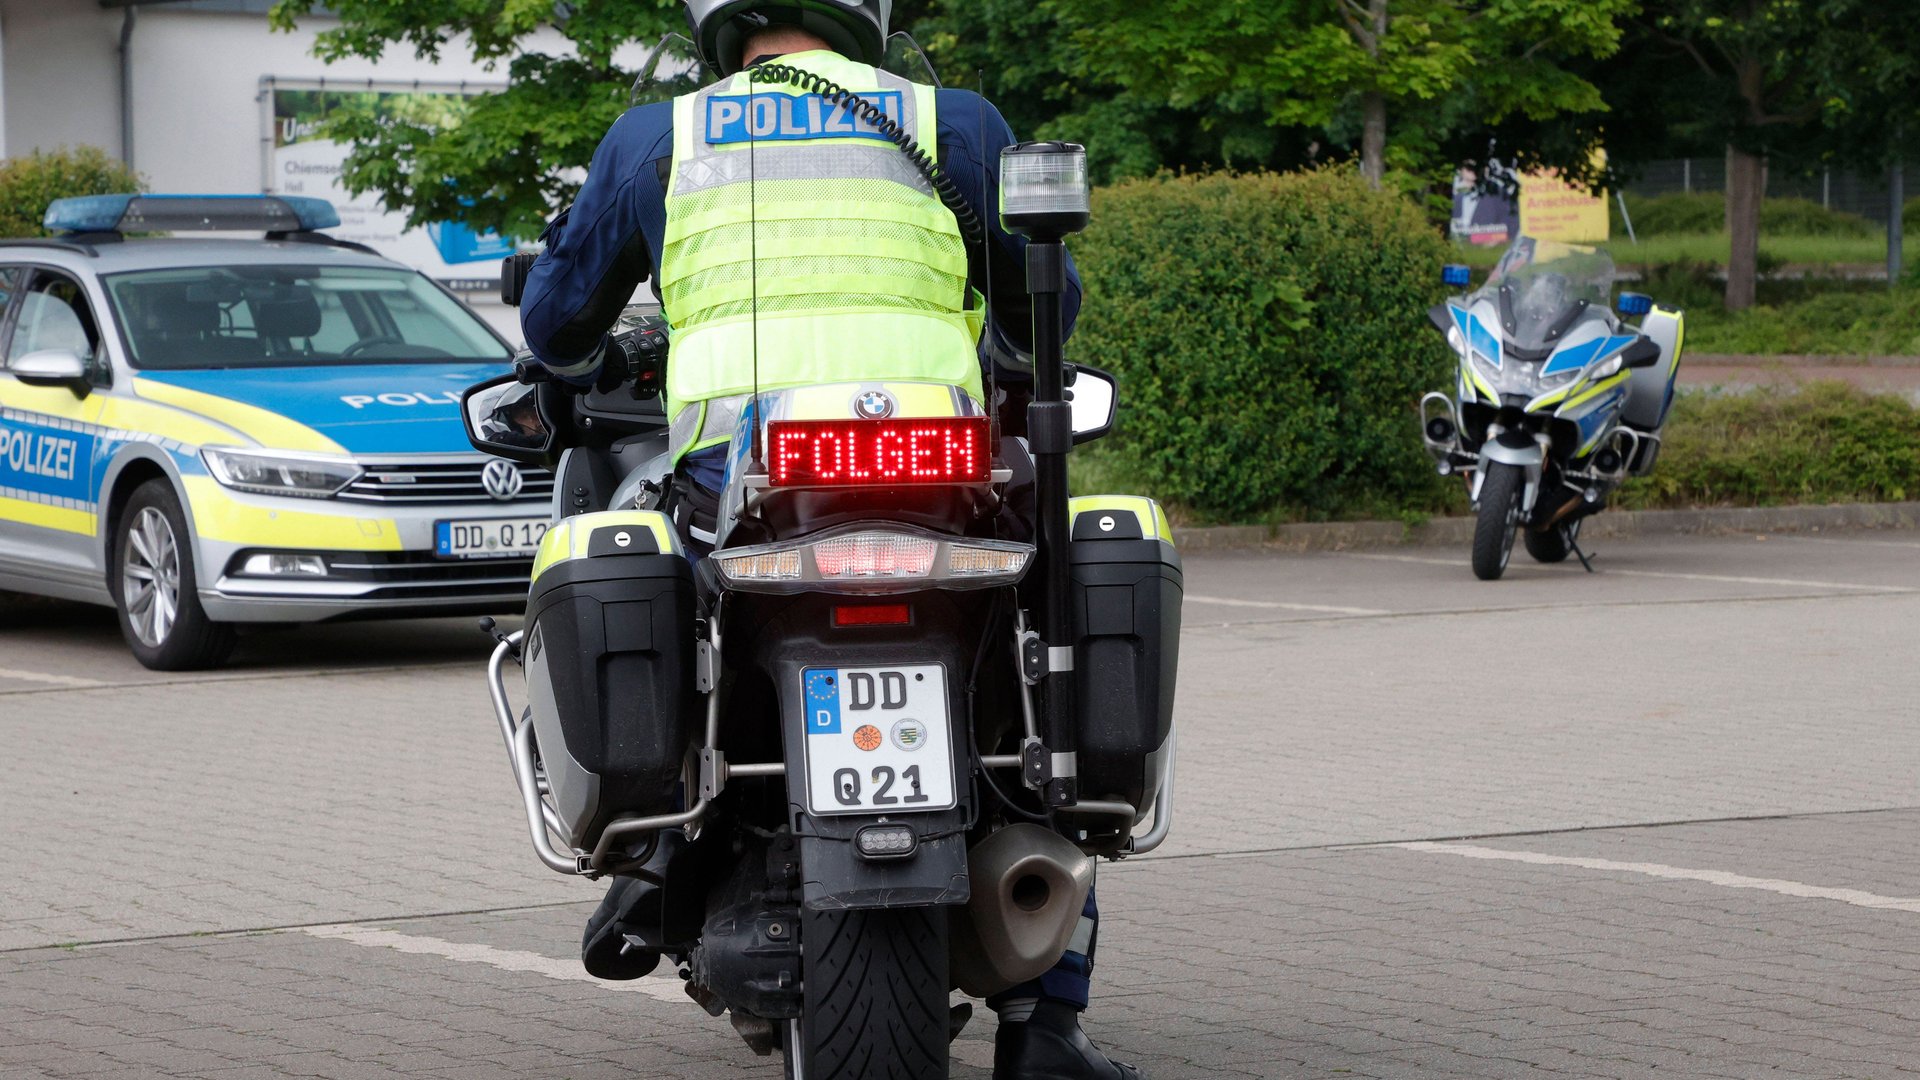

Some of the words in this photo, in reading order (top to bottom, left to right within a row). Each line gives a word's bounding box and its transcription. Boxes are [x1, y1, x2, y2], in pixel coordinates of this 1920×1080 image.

[710, 95, 898, 139] POLIZEI
[339, 391, 463, 409] POLI
[0, 428, 77, 481] POLIZEI
[778, 428, 974, 480] FOLGEN
[454, 526, 484, 549] DD
[500, 524, 515, 547] Q
[521, 523, 553, 546] 12
[847, 671, 908, 711] DD
[816, 710, 832, 727] D
